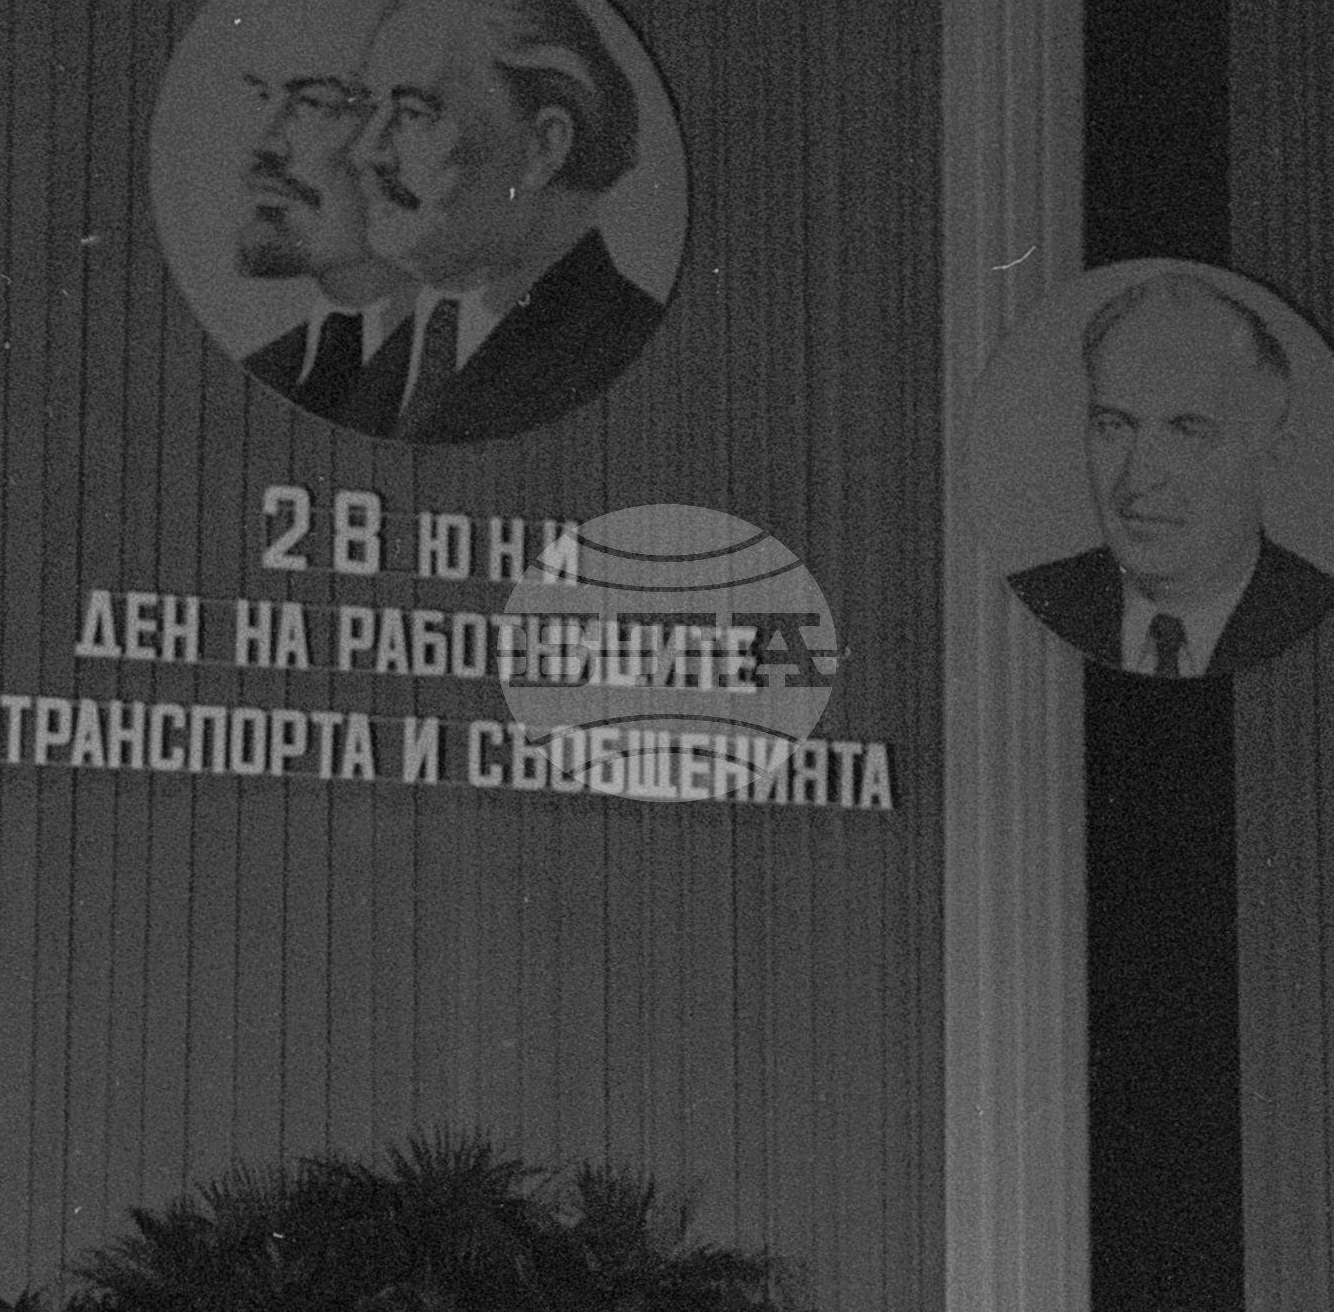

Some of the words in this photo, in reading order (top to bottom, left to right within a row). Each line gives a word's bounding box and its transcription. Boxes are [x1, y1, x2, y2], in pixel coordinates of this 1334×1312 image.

[262, 486, 381, 575] 28
[418, 511, 578, 587] ЮНИ
[74, 589, 200, 663] ДЕН
[235, 598, 309, 670] НА
[338, 605, 758, 694] РАБОТНИЦИТЕ
[0, 695, 375, 781] ТРАНСПОРТА
[403, 716, 440, 785] И
[467, 721, 893, 810] СЪОБЩЕНИЯТА
